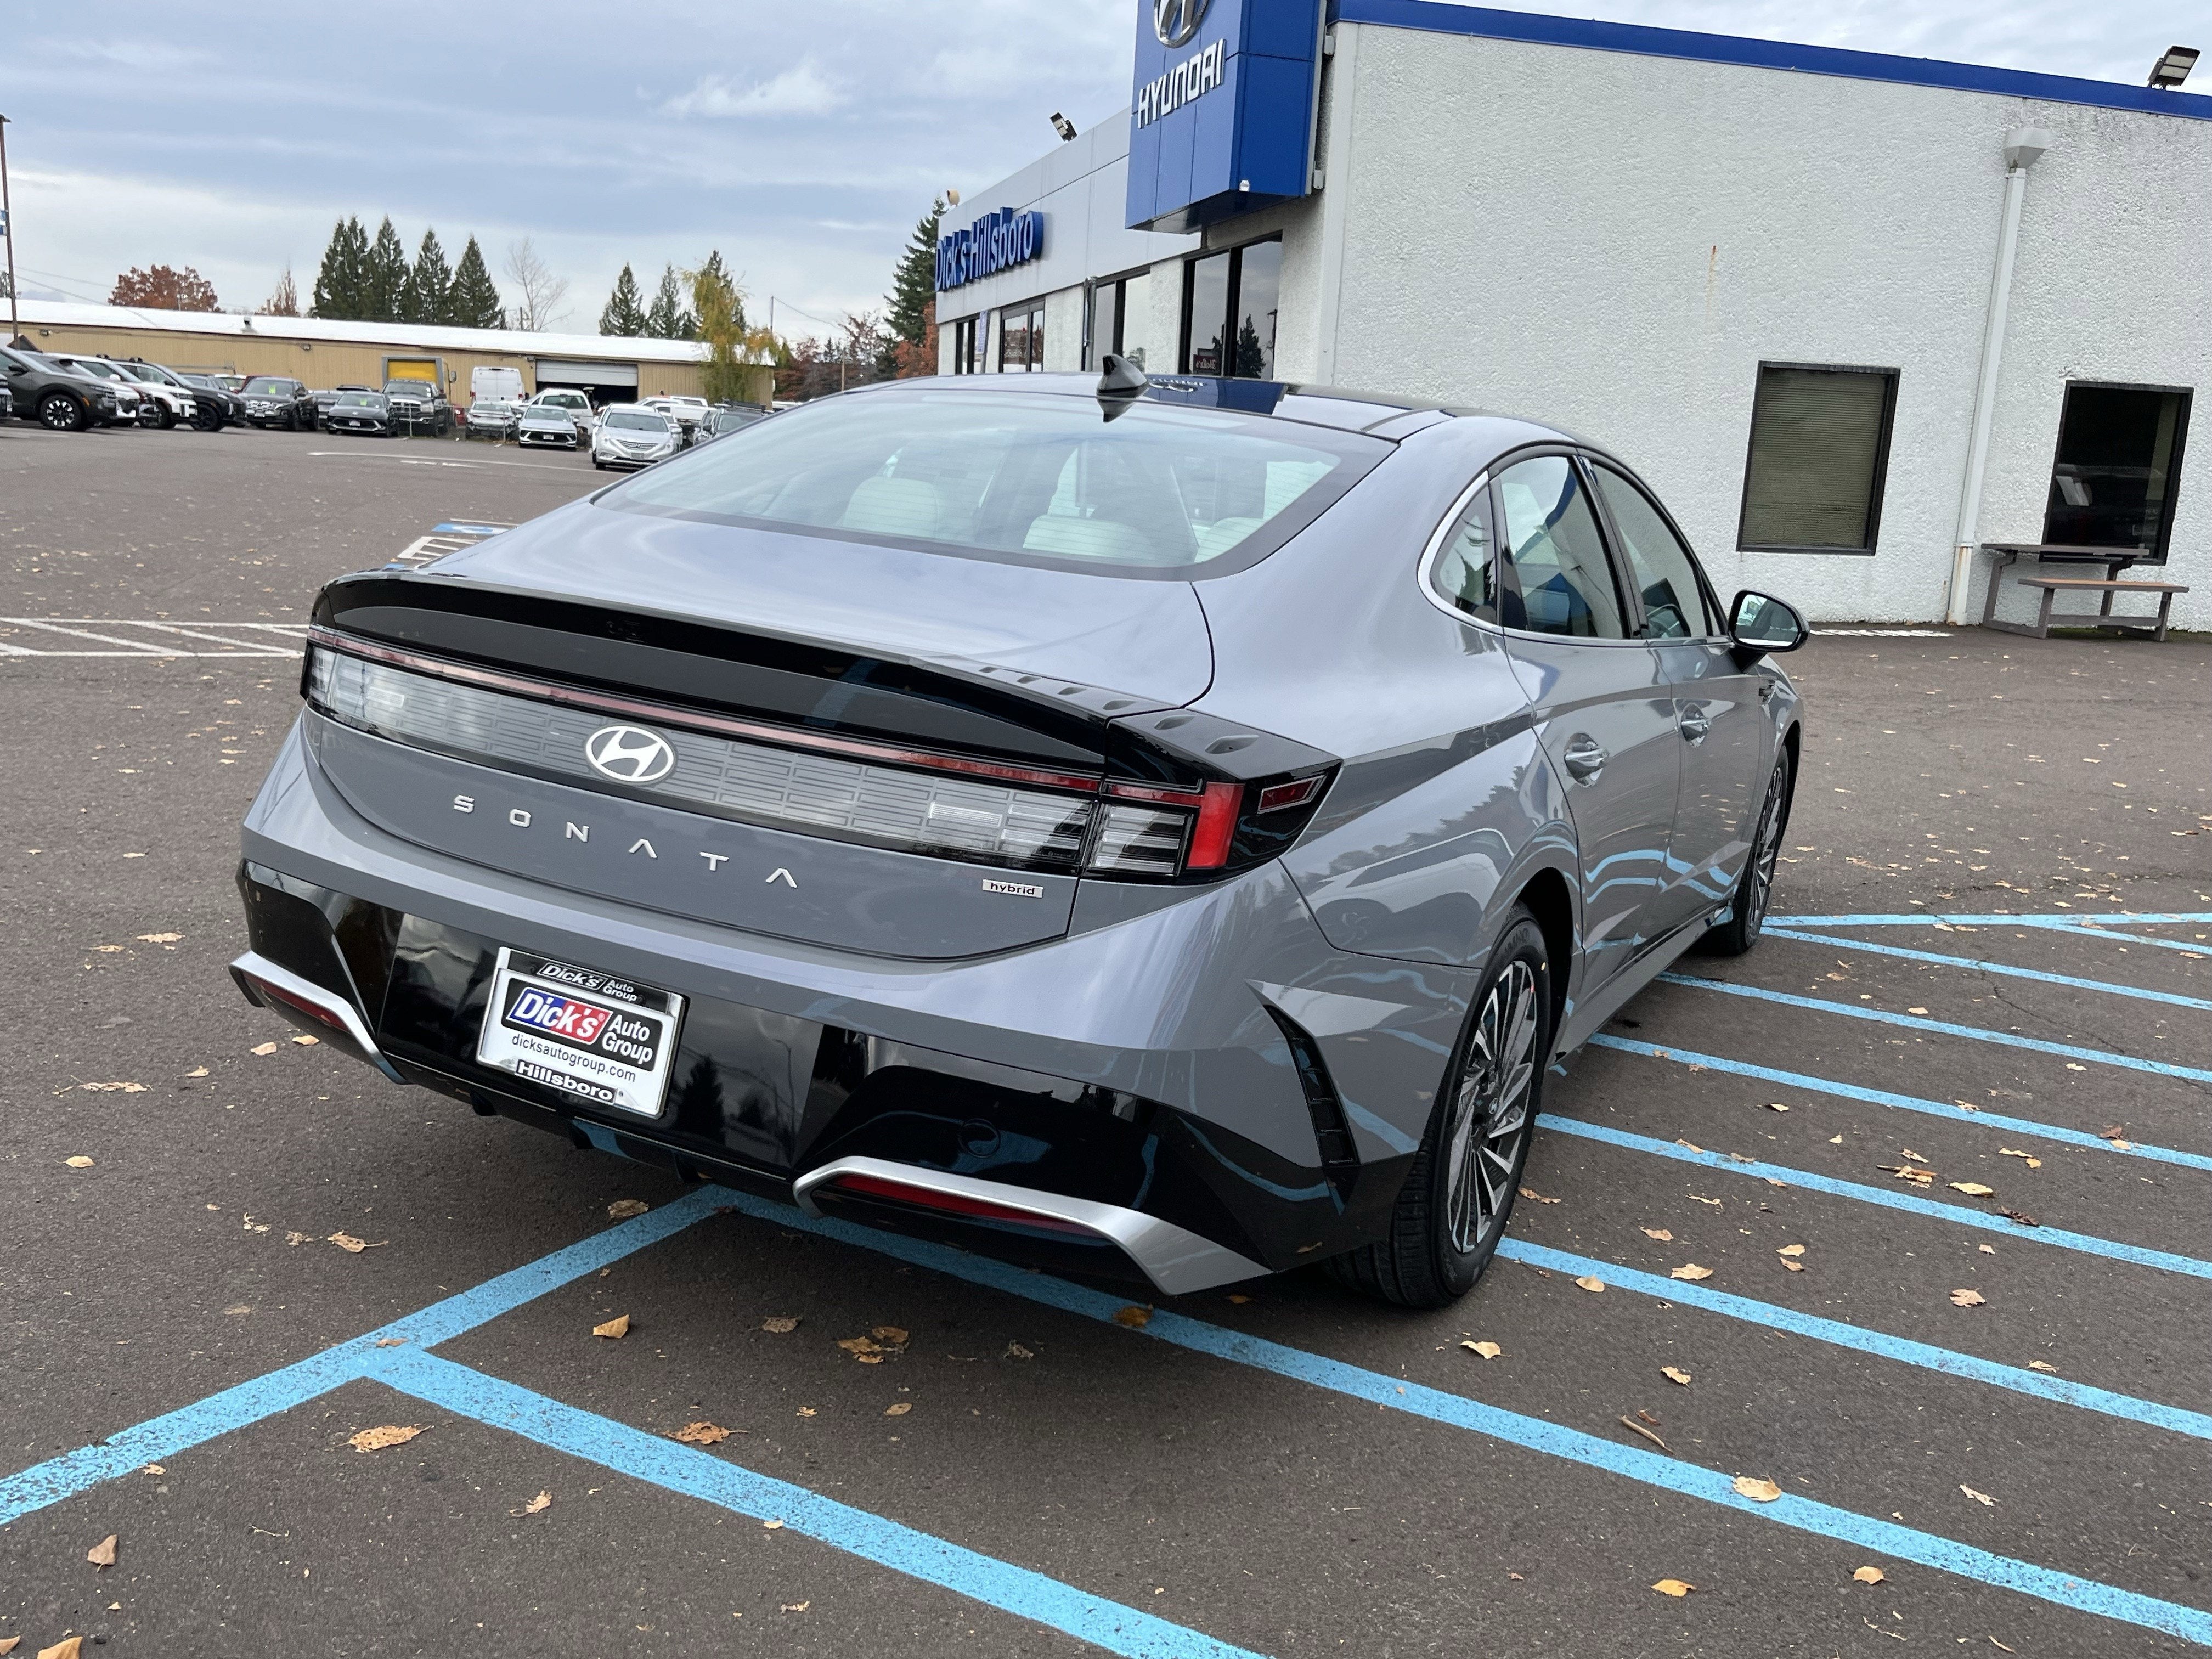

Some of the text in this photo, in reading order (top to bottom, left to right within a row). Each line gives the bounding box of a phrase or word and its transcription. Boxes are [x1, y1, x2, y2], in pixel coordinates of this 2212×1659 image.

[1137, 38, 1226, 129] HYUNDAI
[935, 206, 1036, 292] Dick's Hillsboro
[453, 795, 798, 888] SONATA
[991, 882, 1035, 895] hybrid
[542, 964, 601, 988] Dick's
[607, 979, 634, 993] Auto
[604, 987, 637, 1003] Group
[515, 991, 600, 1039] Dick's
[608, 1014, 650, 1041] Auto
[511, 1033, 636, 1082] dicksautogroup.com
[602, 1032, 653, 1064] Group
[517, 1060, 613, 1102] Hillsboro
